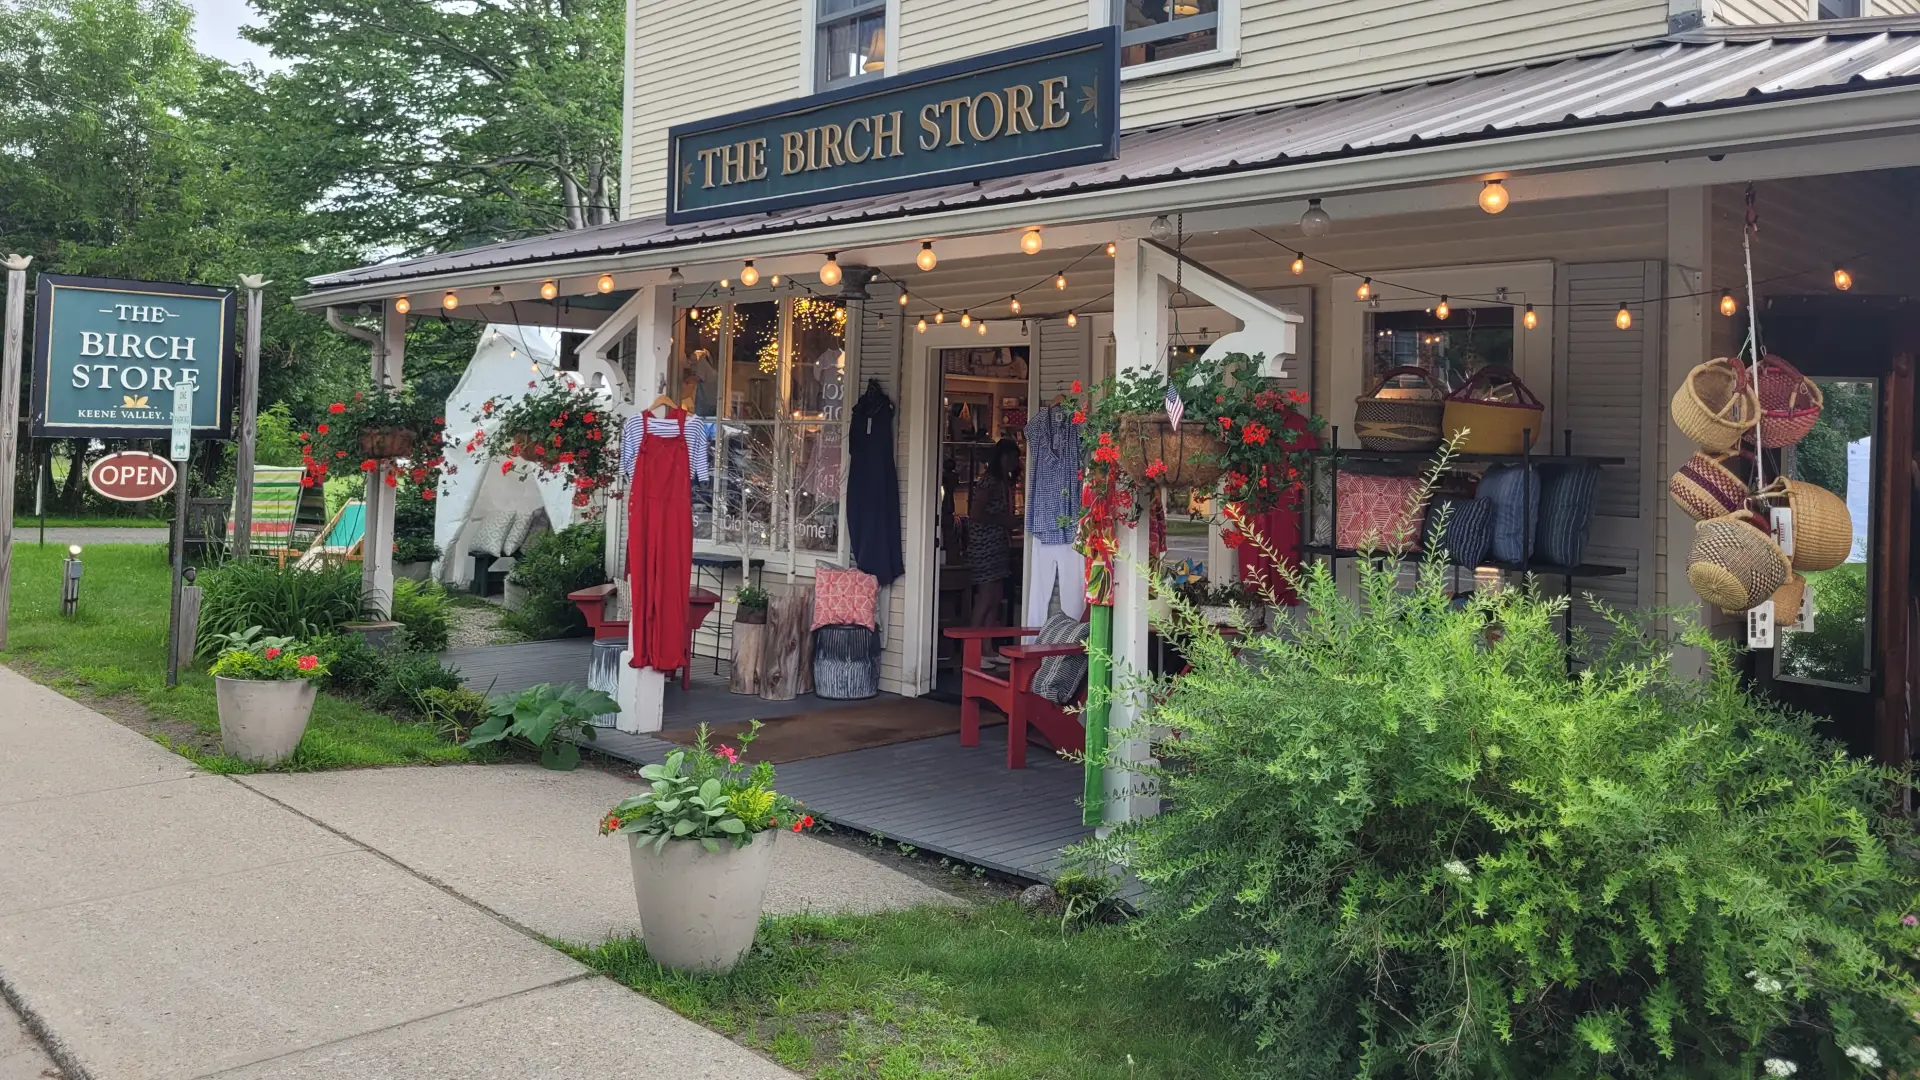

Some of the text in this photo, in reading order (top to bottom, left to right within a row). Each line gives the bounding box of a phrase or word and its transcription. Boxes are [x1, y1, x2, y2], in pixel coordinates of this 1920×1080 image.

[698, 75, 1070, 189] THE BIRCH STORE
[80, 331, 197, 361] BIRCH
[72, 364, 200, 392] STORE
[78, 409, 117, 419] KEENE
[121, 410, 165, 420] VALLEY,
[99, 465, 167, 486] OPEN
[798, 521, 826, 539] ome
